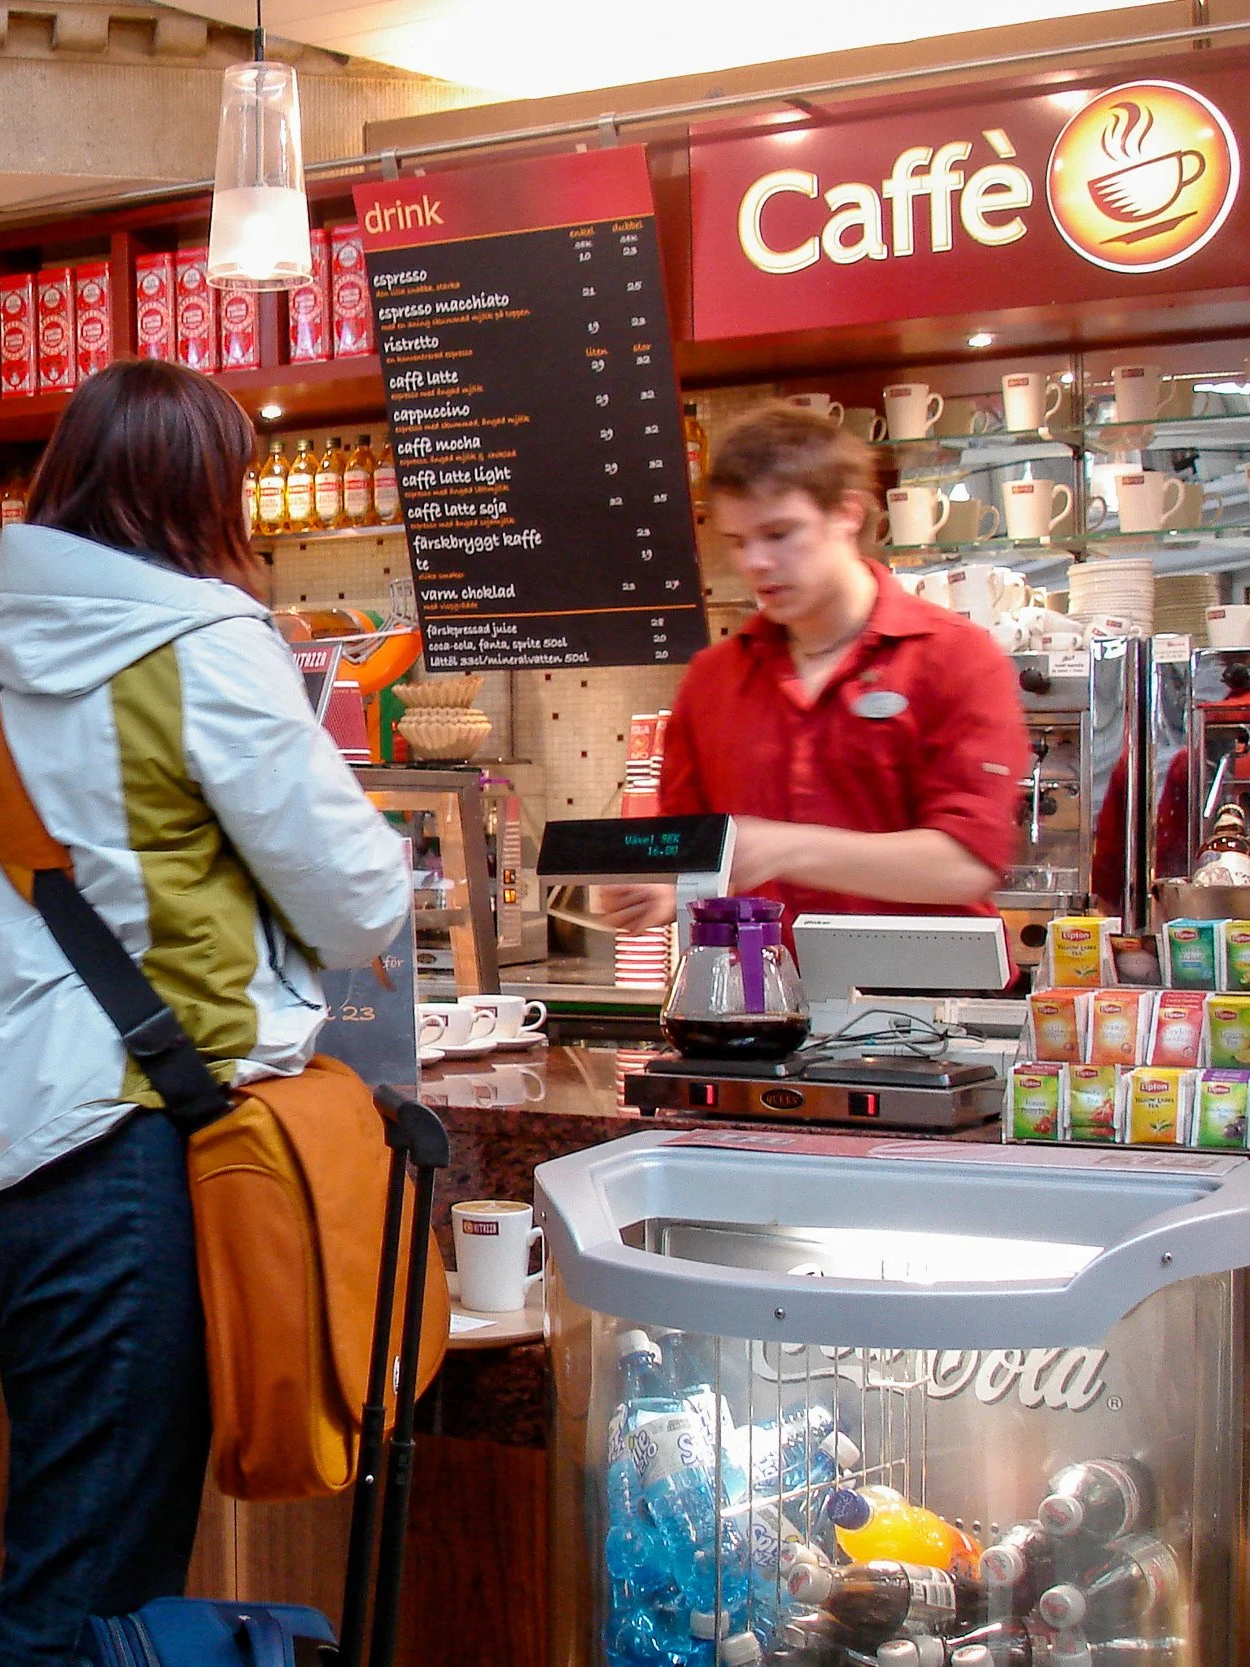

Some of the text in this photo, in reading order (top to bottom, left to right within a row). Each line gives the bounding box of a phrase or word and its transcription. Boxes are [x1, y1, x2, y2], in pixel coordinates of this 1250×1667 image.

[737, 128, 1033, 275] Caffè
[365, 195, 444, 234] drink
[373, 269, 428, 291] espresso
[378, 304, 432, 324] espresso
[435, 292, 510, 314] macchiato
[383, 335, 439, 353] ristretto
[389, 370, 424, 392] caffè
[427, 370, 459, 386] latte
[393, 401, 471, 425] cappuccino
[397, 436, 432, 457] caffè
[436, 434, 481, 451] mocha
[402, 469, 437, 490] caffè
[440, 469, 472, 485] latte
[474, 465, 511, 486] light
[407, 503, 442, 522] caffè
[444, 502, 477, 517] latte
[479, 498, 507, 519] soja
[413, 534, 500, 555] färskbryggt
[502, 529, 542, 549] kaffe
[416, 558, 430, 571] te
[421, 589, 458, 601] varm
[461, 584, 516, 600] choklad
[426, 623, 491, 639] färskpressad
[492, 622, 518, 638] juice
[512, 638, 541, 653] sprite
[542, 637, 568, 649] 50cl
[564, 652, 589, 663] 50cl
[1062, 930, 1091, 941] Lipton
[342, 1005, 376, 1021] 23
[1141, 1081, 1168, 1092] Lipton
